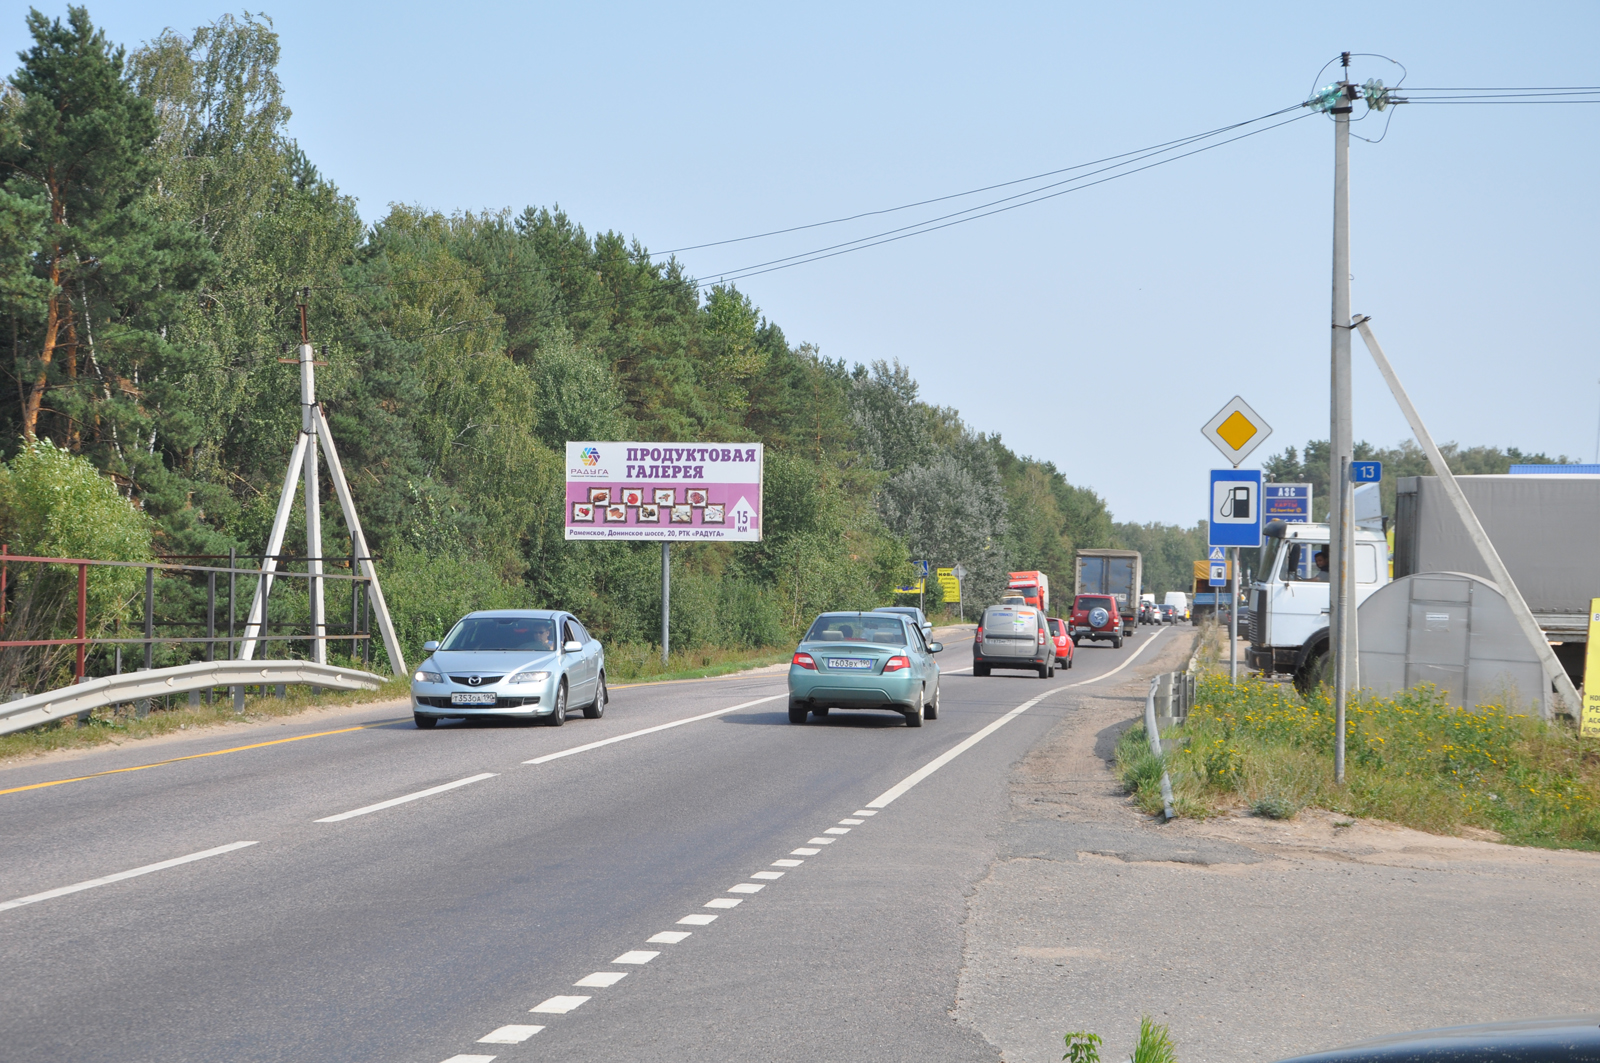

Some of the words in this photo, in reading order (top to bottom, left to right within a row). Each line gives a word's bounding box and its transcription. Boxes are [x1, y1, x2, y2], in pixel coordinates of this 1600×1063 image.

[626, 448, 756, 464] ПРОДУКТОВАЯ
[626, 465, 704, 479] ГАЛЕРЕЯ
[1360, 466, 1375, 478] 13
[1278, 487, 1296, 496] АЗС
[736, 511, 748, 524] 15
[569, 529, 606, 537] Раменское,
